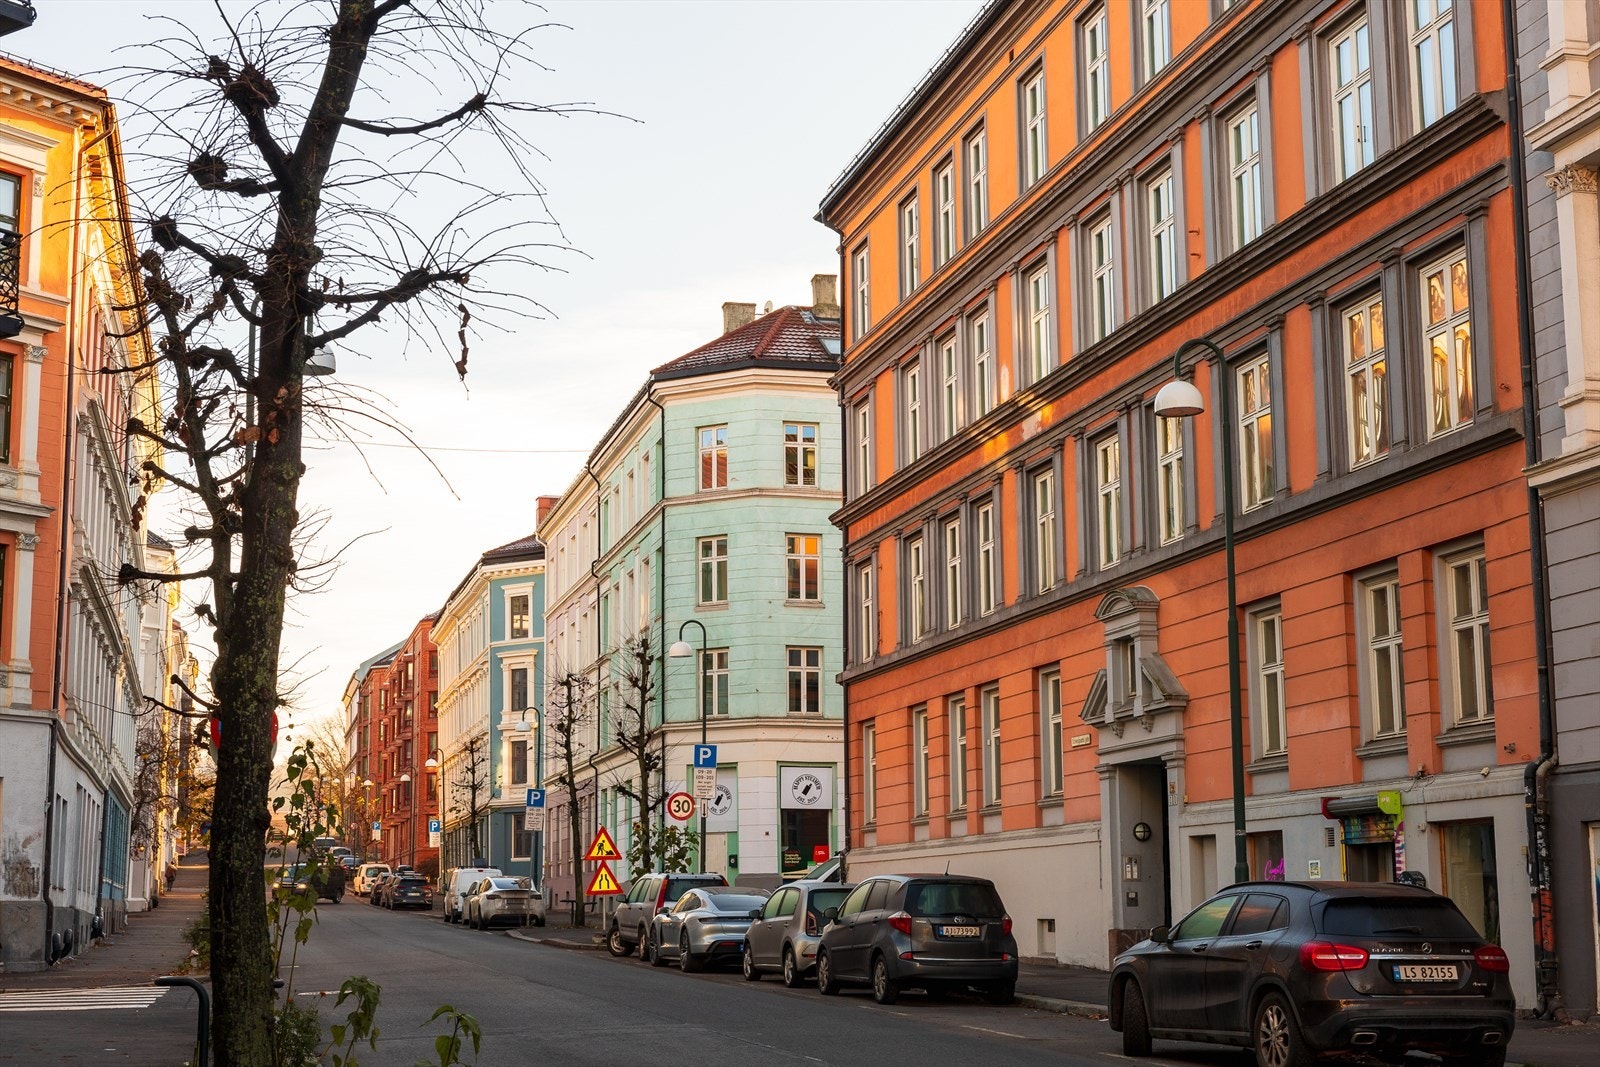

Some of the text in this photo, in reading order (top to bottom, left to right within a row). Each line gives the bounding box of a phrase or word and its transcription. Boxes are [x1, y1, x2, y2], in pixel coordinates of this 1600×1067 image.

[699, 747, 712, 765] P
[793, 775, 821, 790] HAPPY STEAMER
[530, 791, 541, 805] P
[673, 799, 690, 813] 30
[431, 821, 438, 831] P
[956, 926, 978, 935] 73992
[1403, 967, 1454, 978] LS 82155
